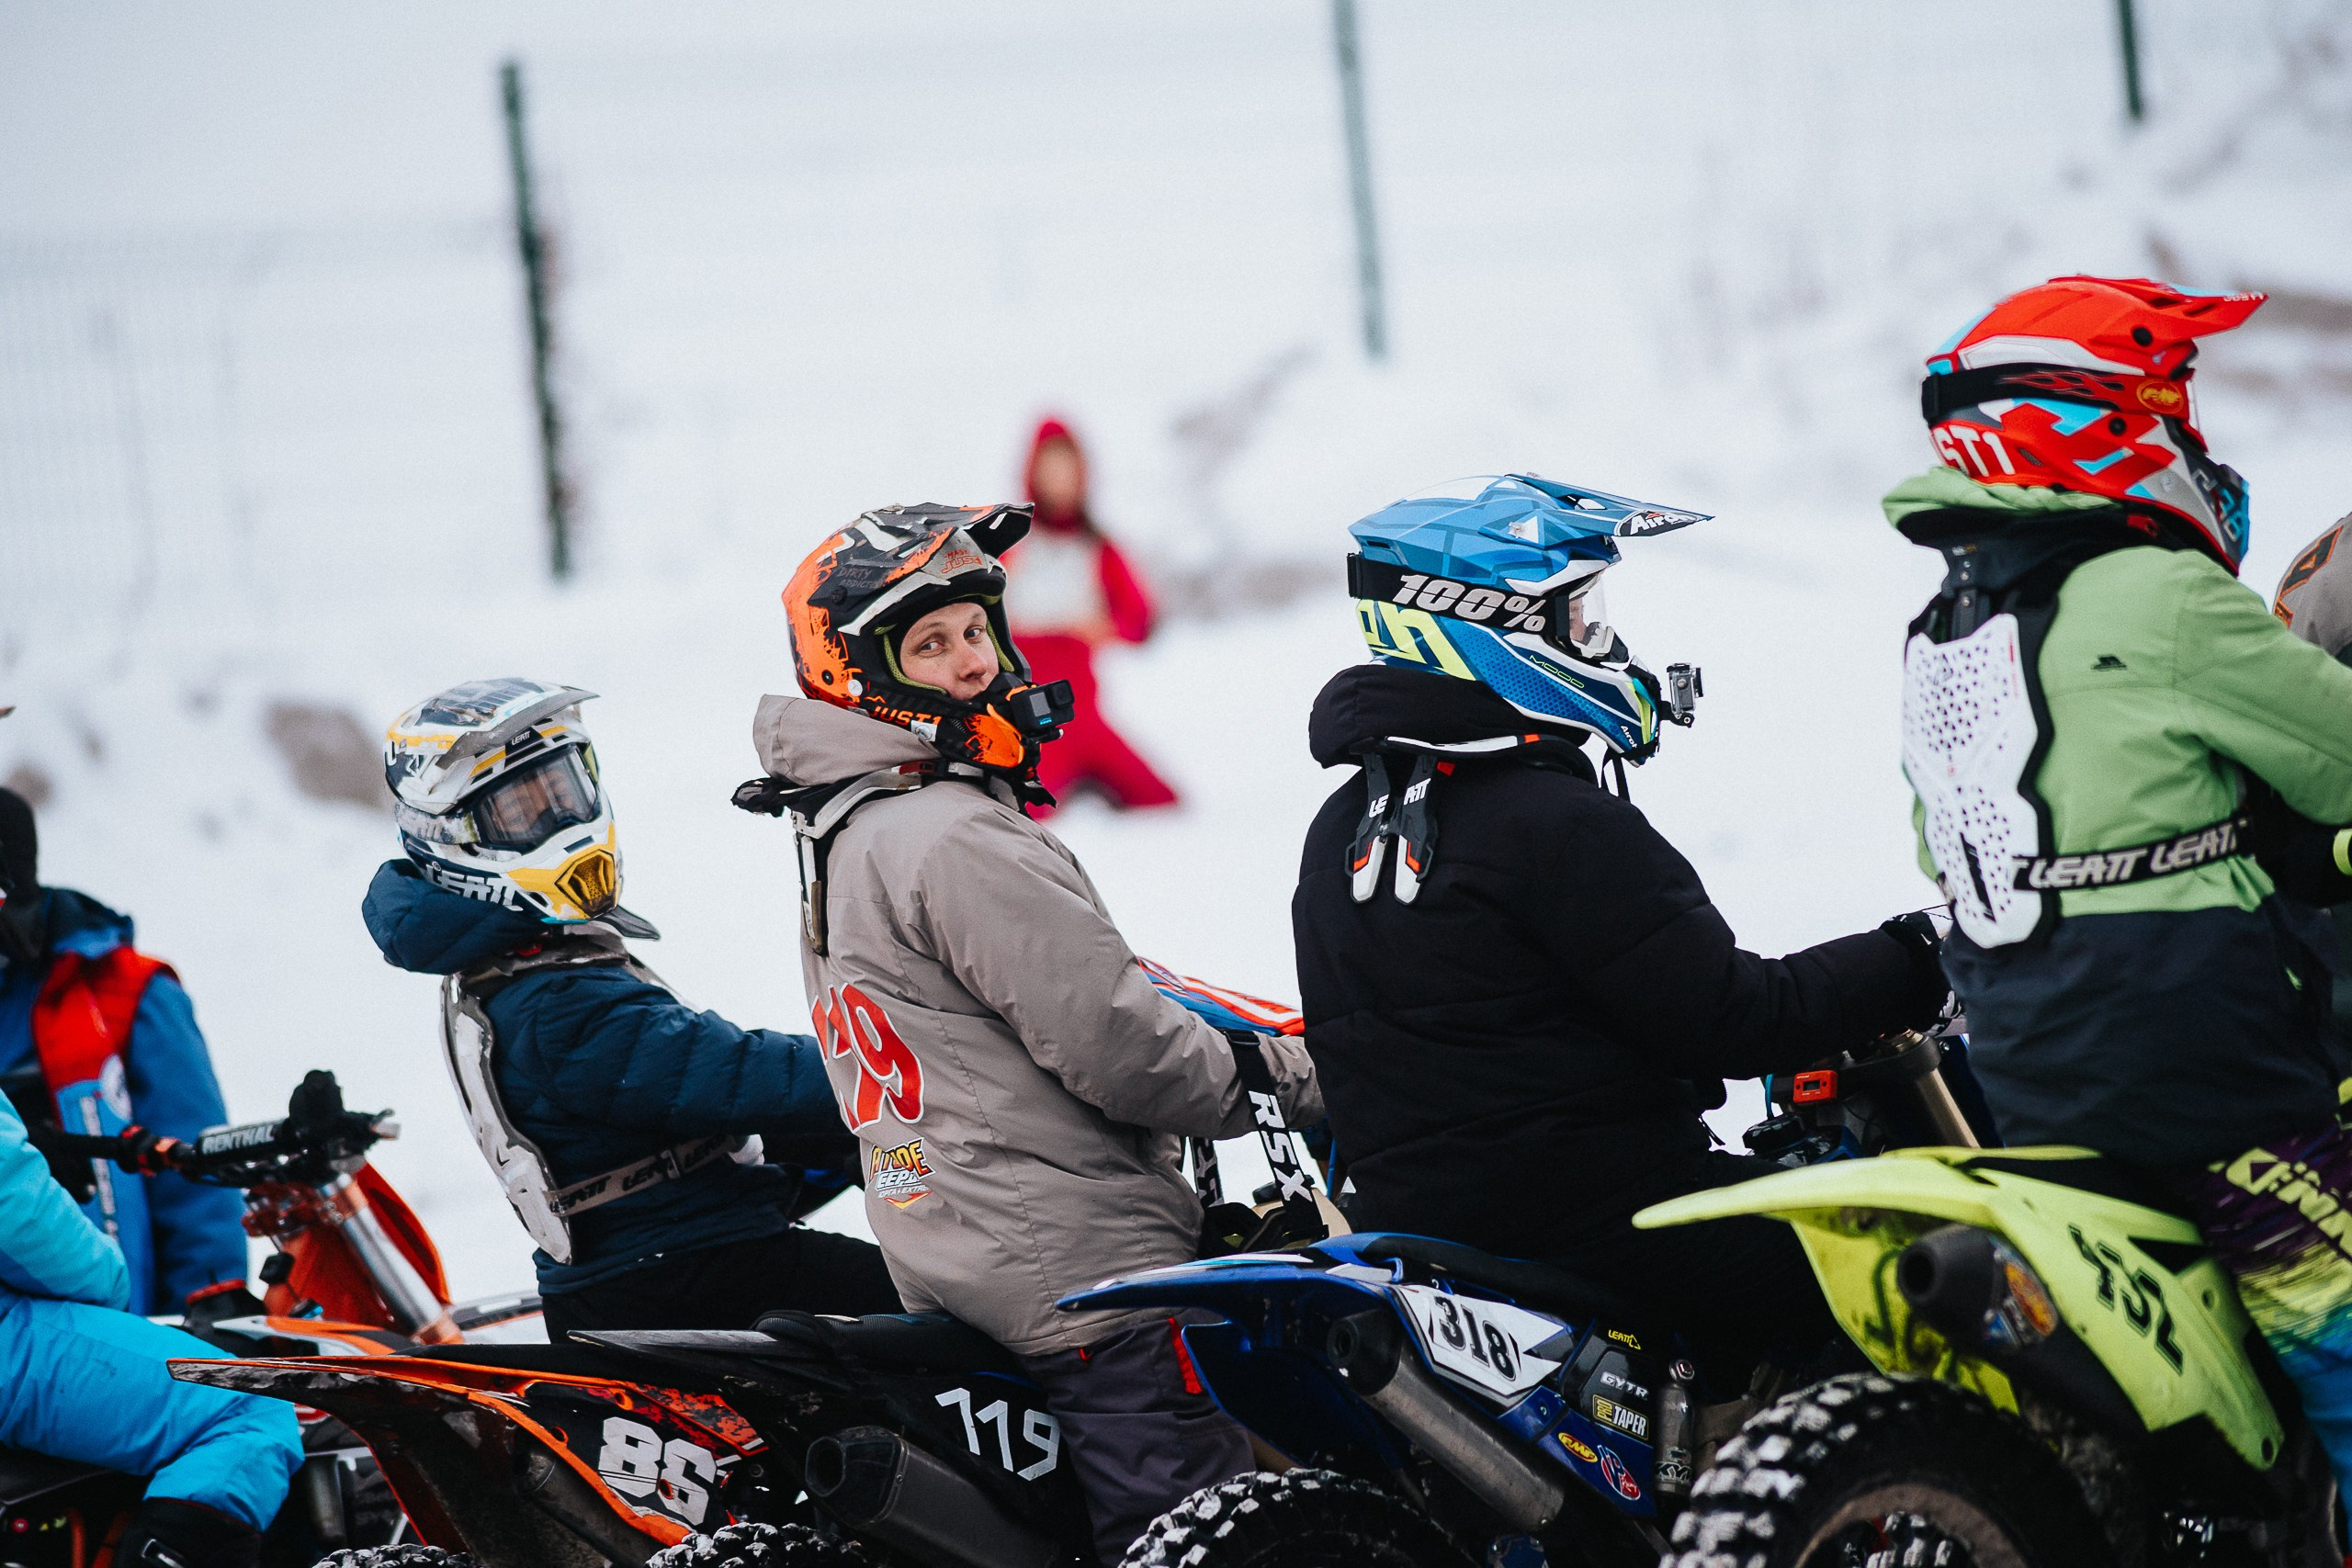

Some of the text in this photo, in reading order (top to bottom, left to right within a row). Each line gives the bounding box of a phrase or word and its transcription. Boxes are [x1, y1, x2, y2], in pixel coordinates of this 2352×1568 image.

[1392, 574, 1546, 632] 100%
[1529, 654, 1585, 689] MOOD
[511, 730, 531, 745] LEATT
[2029, 848, 2148, 889] LEATT
[202, 1123, 276, 1155] RENTHAL
[1249, 1090, 1313, 1201] RSX
[1433, 1295, 1517, 1382] 318
[1608, 1329, 1631, 1344] LEATT
[1600, 1371, 1650, 1399] GYTR
[1613, 1405, 1647, 1436] TAPER
[598, 1416, 718, 1526] 86
